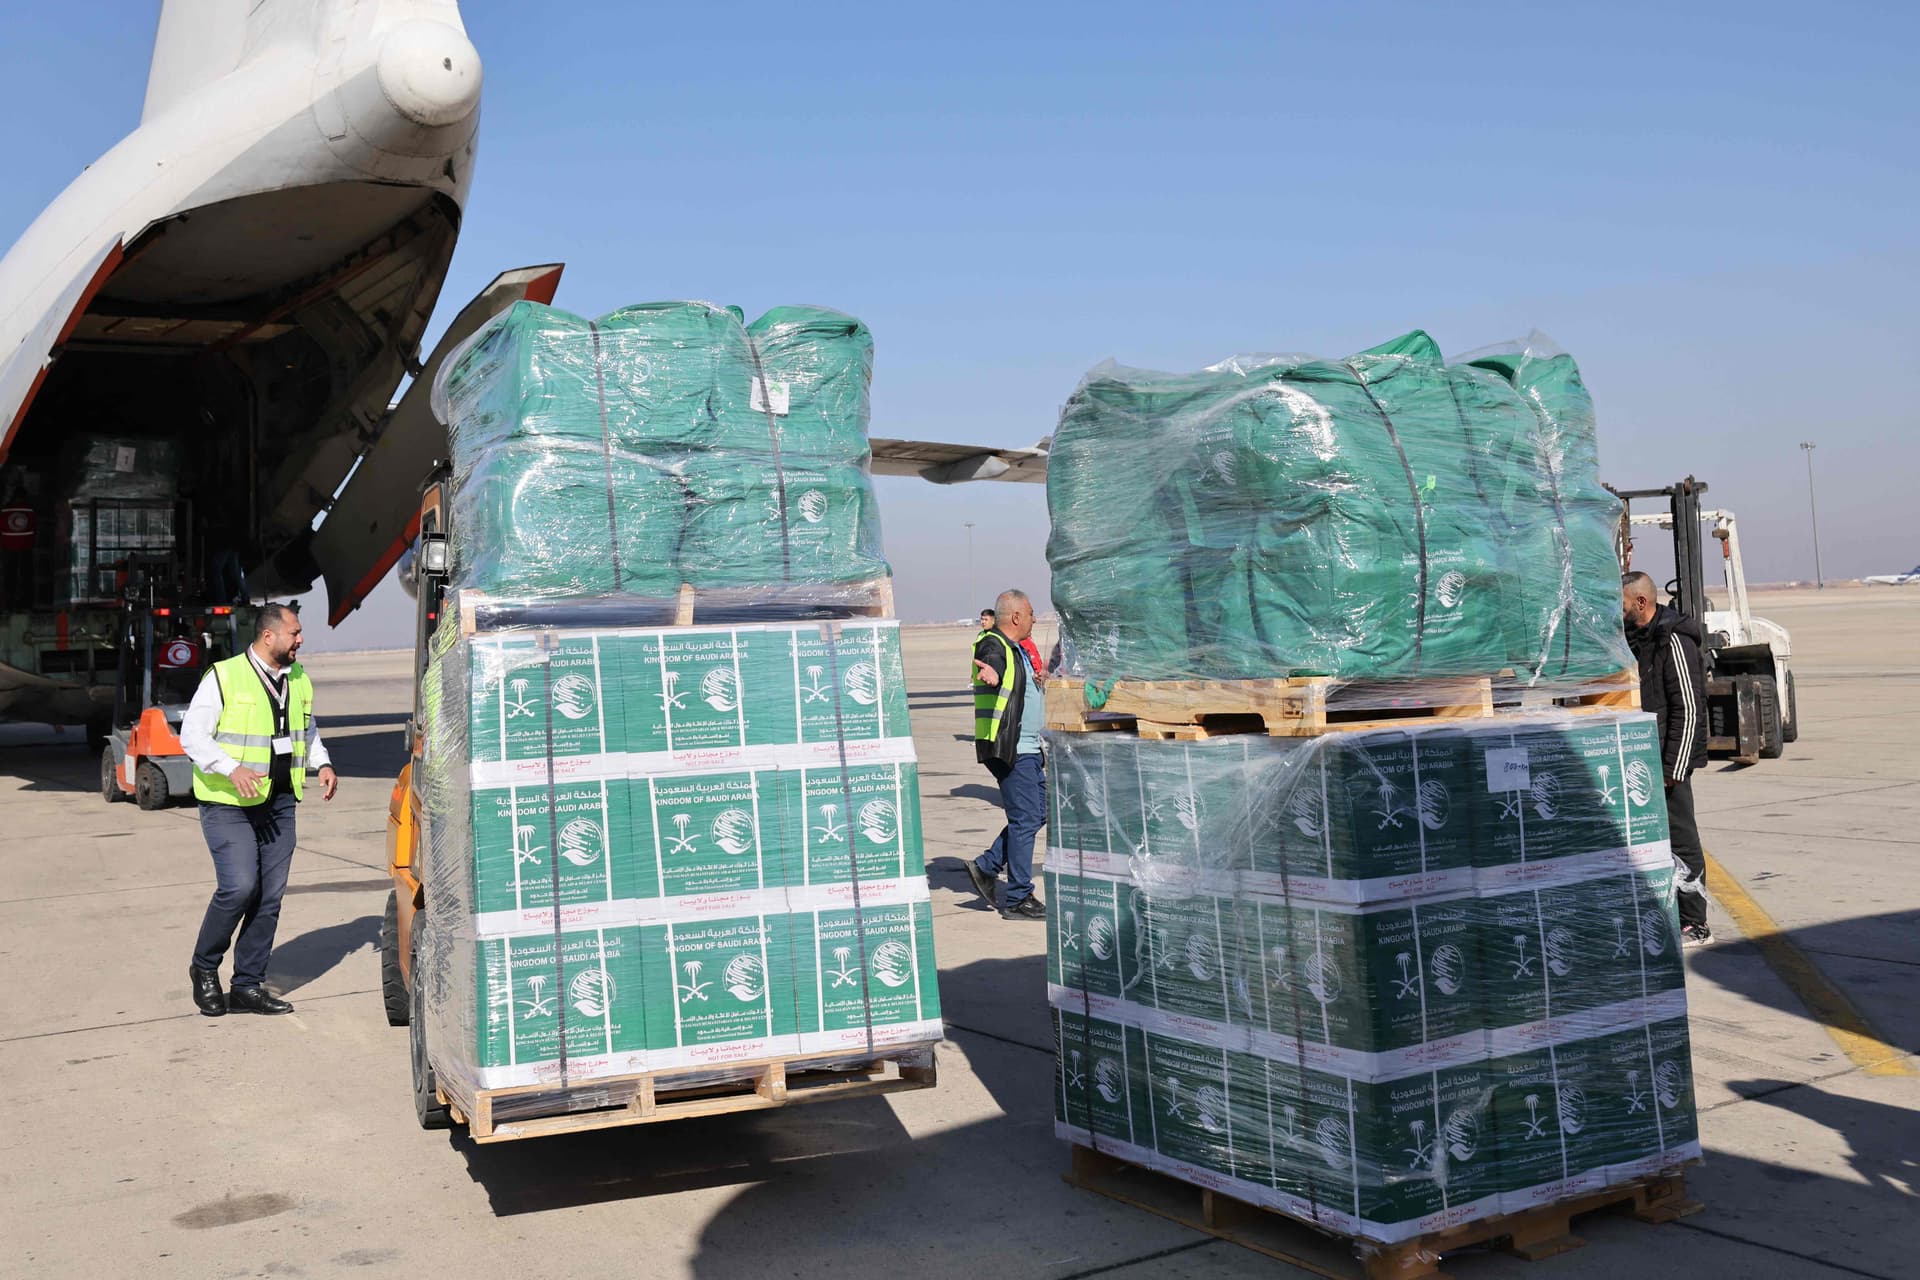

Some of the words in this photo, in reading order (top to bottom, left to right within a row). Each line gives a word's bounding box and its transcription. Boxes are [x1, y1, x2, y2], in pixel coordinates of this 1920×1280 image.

[642, 643, 684, 654] السعدية
[715, 640, 748, 649] الملكة
[695, 653, 718, 661] SAUDI
[720, 652, 748, 660] ARAIA
[788, 649, 824, 658] KNGDOM
[860, 647, 888, 656] ARAIA
[548, 658, 569, 668] AUDI
[570, 657, 600, 667] ARAB
[1407, 763, 1428, 772] SDI
[848, 772, 870, 784] العربي
[870, 771, 902, 780] امملكة
[726, 780, 760, 790] امملكة
[806, 776, 840, 787] السعودي
[574, 788, 608, 799] امملكة
[852, 785, 874, 793] SAUDI
[496, 794, 540, 807] السعدية
[542, 792, 572, 803] العرة
[656, 797, 691, 806] KINGDOM
[706, 794, 729, 802] SAUDI
[498, 808, 536, 817] KINDOM
[538, 806, 550, 814] OF
[578, 802, 608, 811] ARAB
[885, 912, 916, 921] امملكة
[738, 924, 772, 934] الملكة
[818, 918, 854, 929] السعودي
[664, 930, 706, 942] السعودة
[865, 928, 888, 936] SAUDI
[889, 925, 916, 933] ARAB
[585, 936, 620, 948] الممكة
[666, 944, 703, 953] KNGDOM
[704, 942, 716, 950] OF
[717, 940, 742, 948] SAUDI
[743, 936, 772, 946] ARAA
[510, 944, 550, 958] السعودي
[563, 954, 588, 963] SAUDI
[1392, 1102, 1424, 1113] KINGDOM
